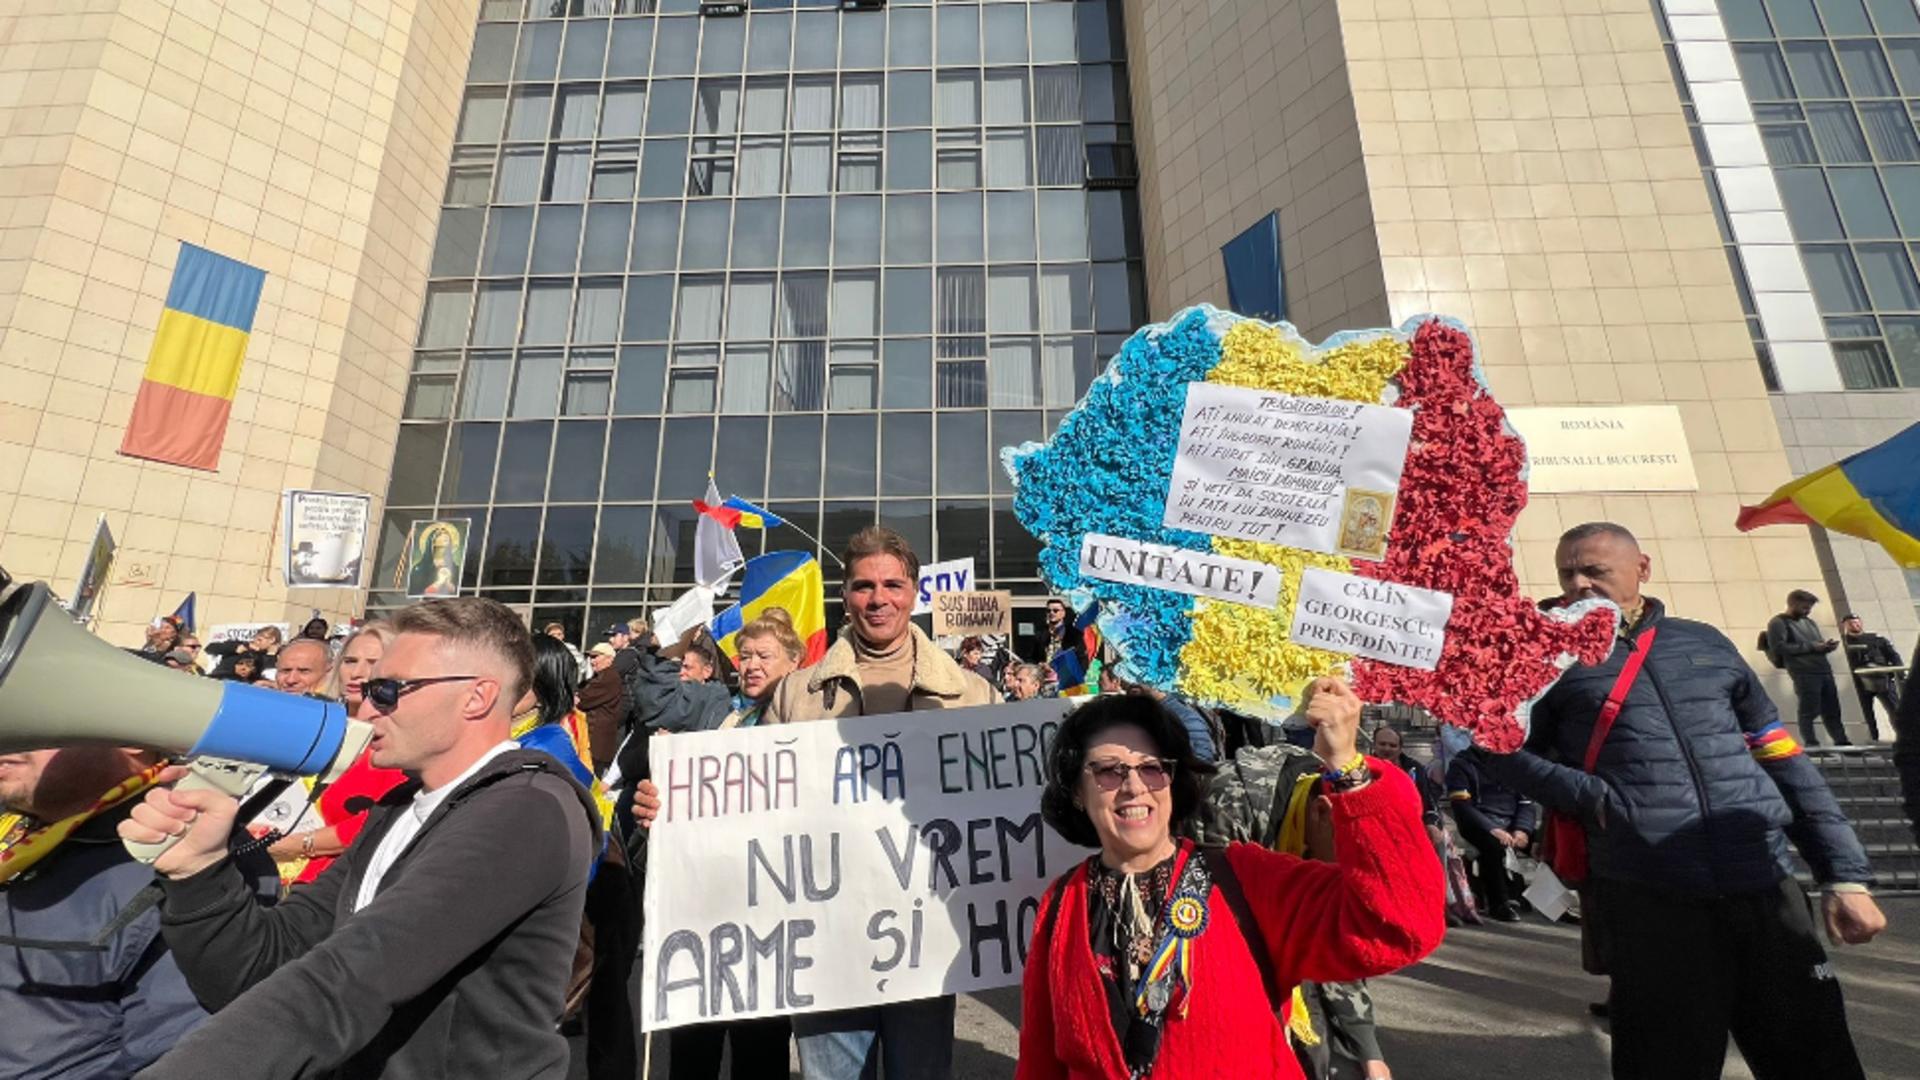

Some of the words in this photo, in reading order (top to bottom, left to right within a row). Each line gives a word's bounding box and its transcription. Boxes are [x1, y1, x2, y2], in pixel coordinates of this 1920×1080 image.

[1560, 417, 1624, 430] ROMÂNIA
[1529, 456, 1605, 467] RIBUNALUL
[1607, 454, 1678, 466] BUCUREȘTI
[1179, 512, 1233, 531] PENTRU
[1088, 544, 1264, 601] UNITATE!
[939, 595, 964, 612] SUS
[1304, 599, 1435, 639] GEORGESCU,
[666, 737, 798, 823] HRANĂ
[833, 731, 905, 805] APĂ
[938, 721, 1060, 794] ENER
[748, 832, 841, 907] NU
[875, 812, 1046, 898] VREM
[655, 918, 816, 1022] ARME
[967, 896, 1040, 978] HO
